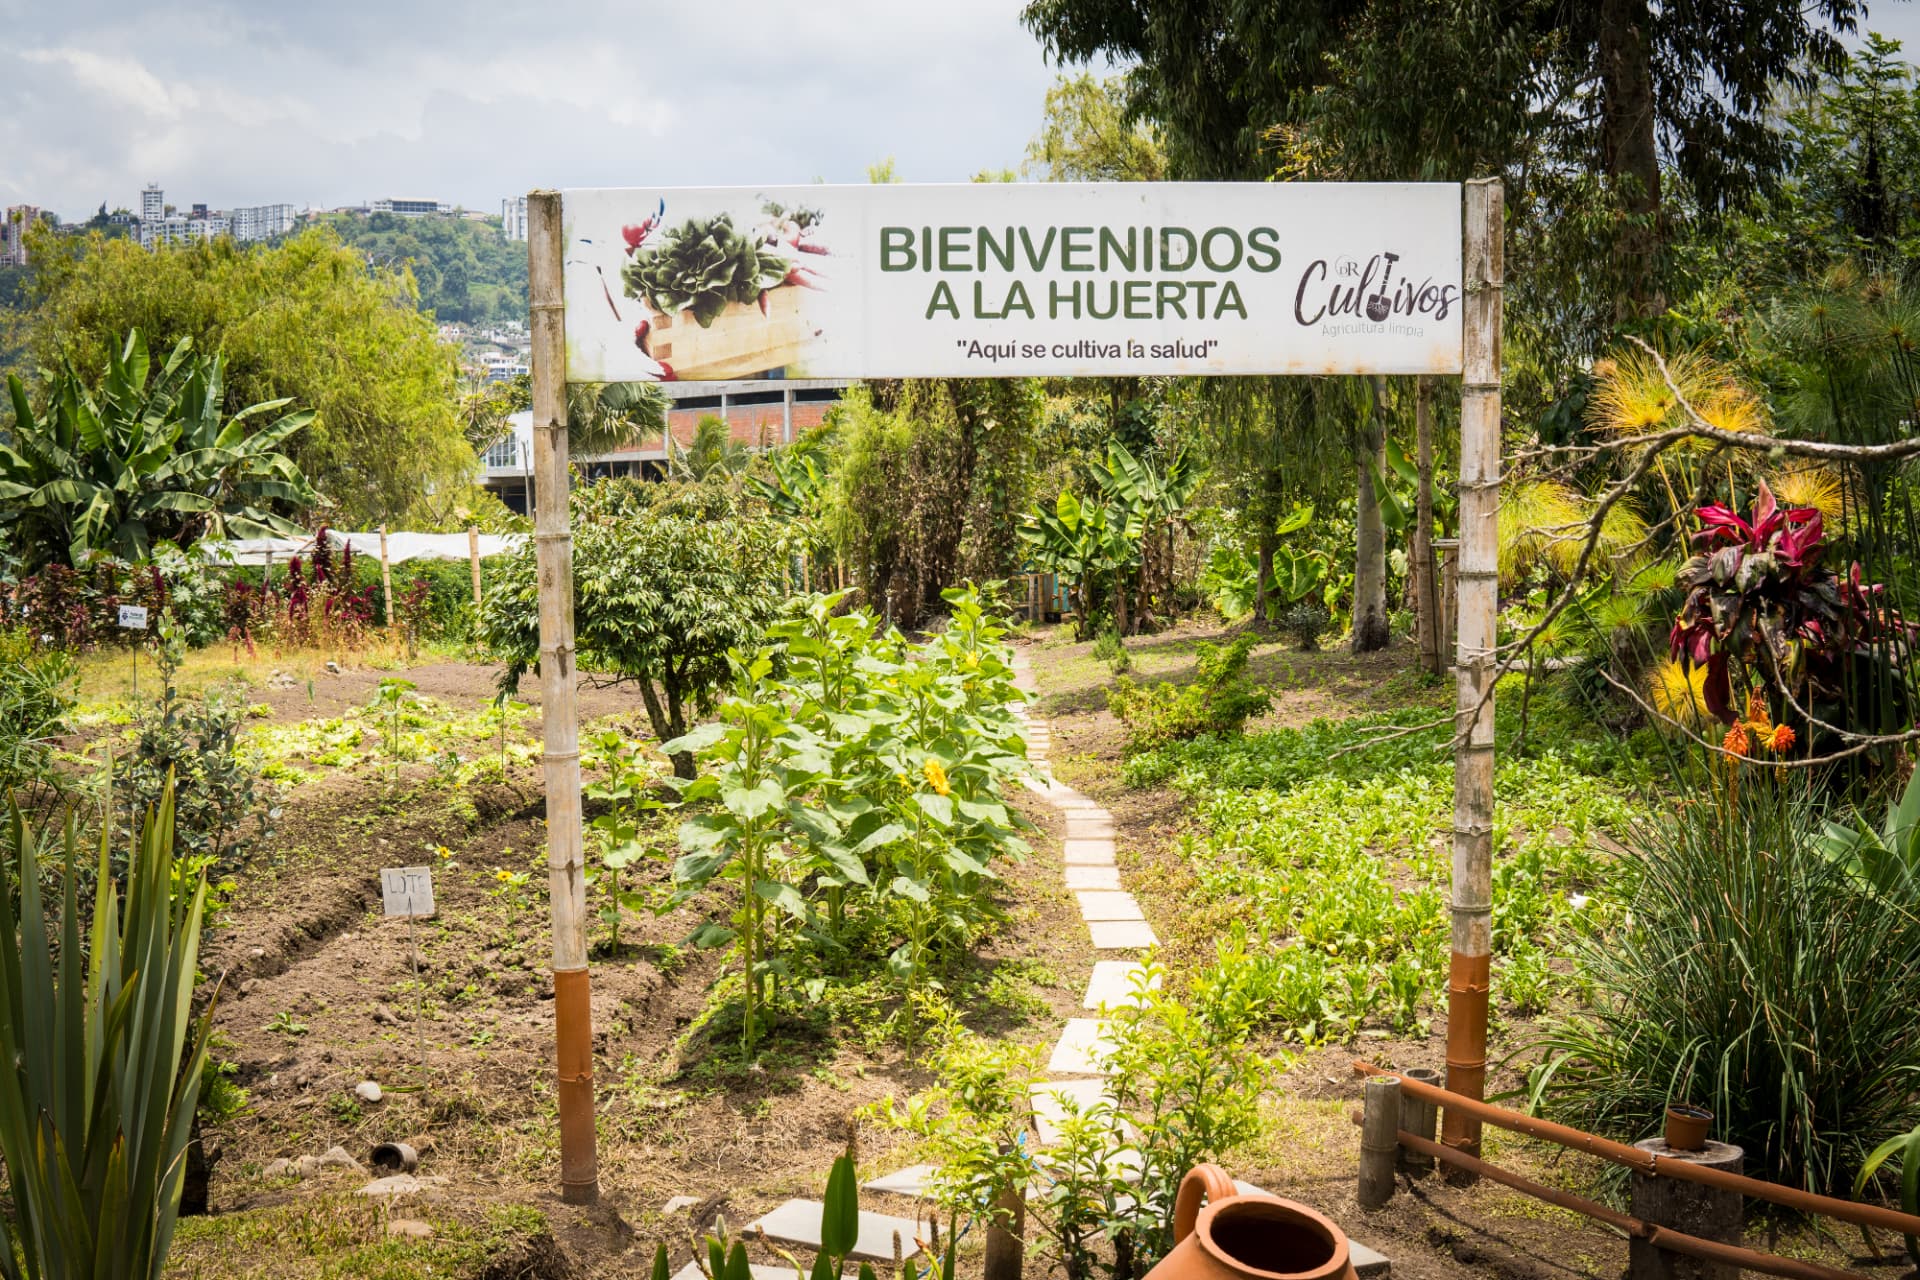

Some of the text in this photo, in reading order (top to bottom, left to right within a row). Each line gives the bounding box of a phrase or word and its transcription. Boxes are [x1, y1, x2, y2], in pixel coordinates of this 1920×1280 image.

[880, 226, 1282, 273] BIENVENIDOS
[925, 280, 1248, 320] A LA HUERTA
[1294, 251, 1460, 327] Cultivos
[1322, 322, 1424, 337] Agricultura limpia
[957, 339, 1218, 363] "Aquí se cultiva la salud"
